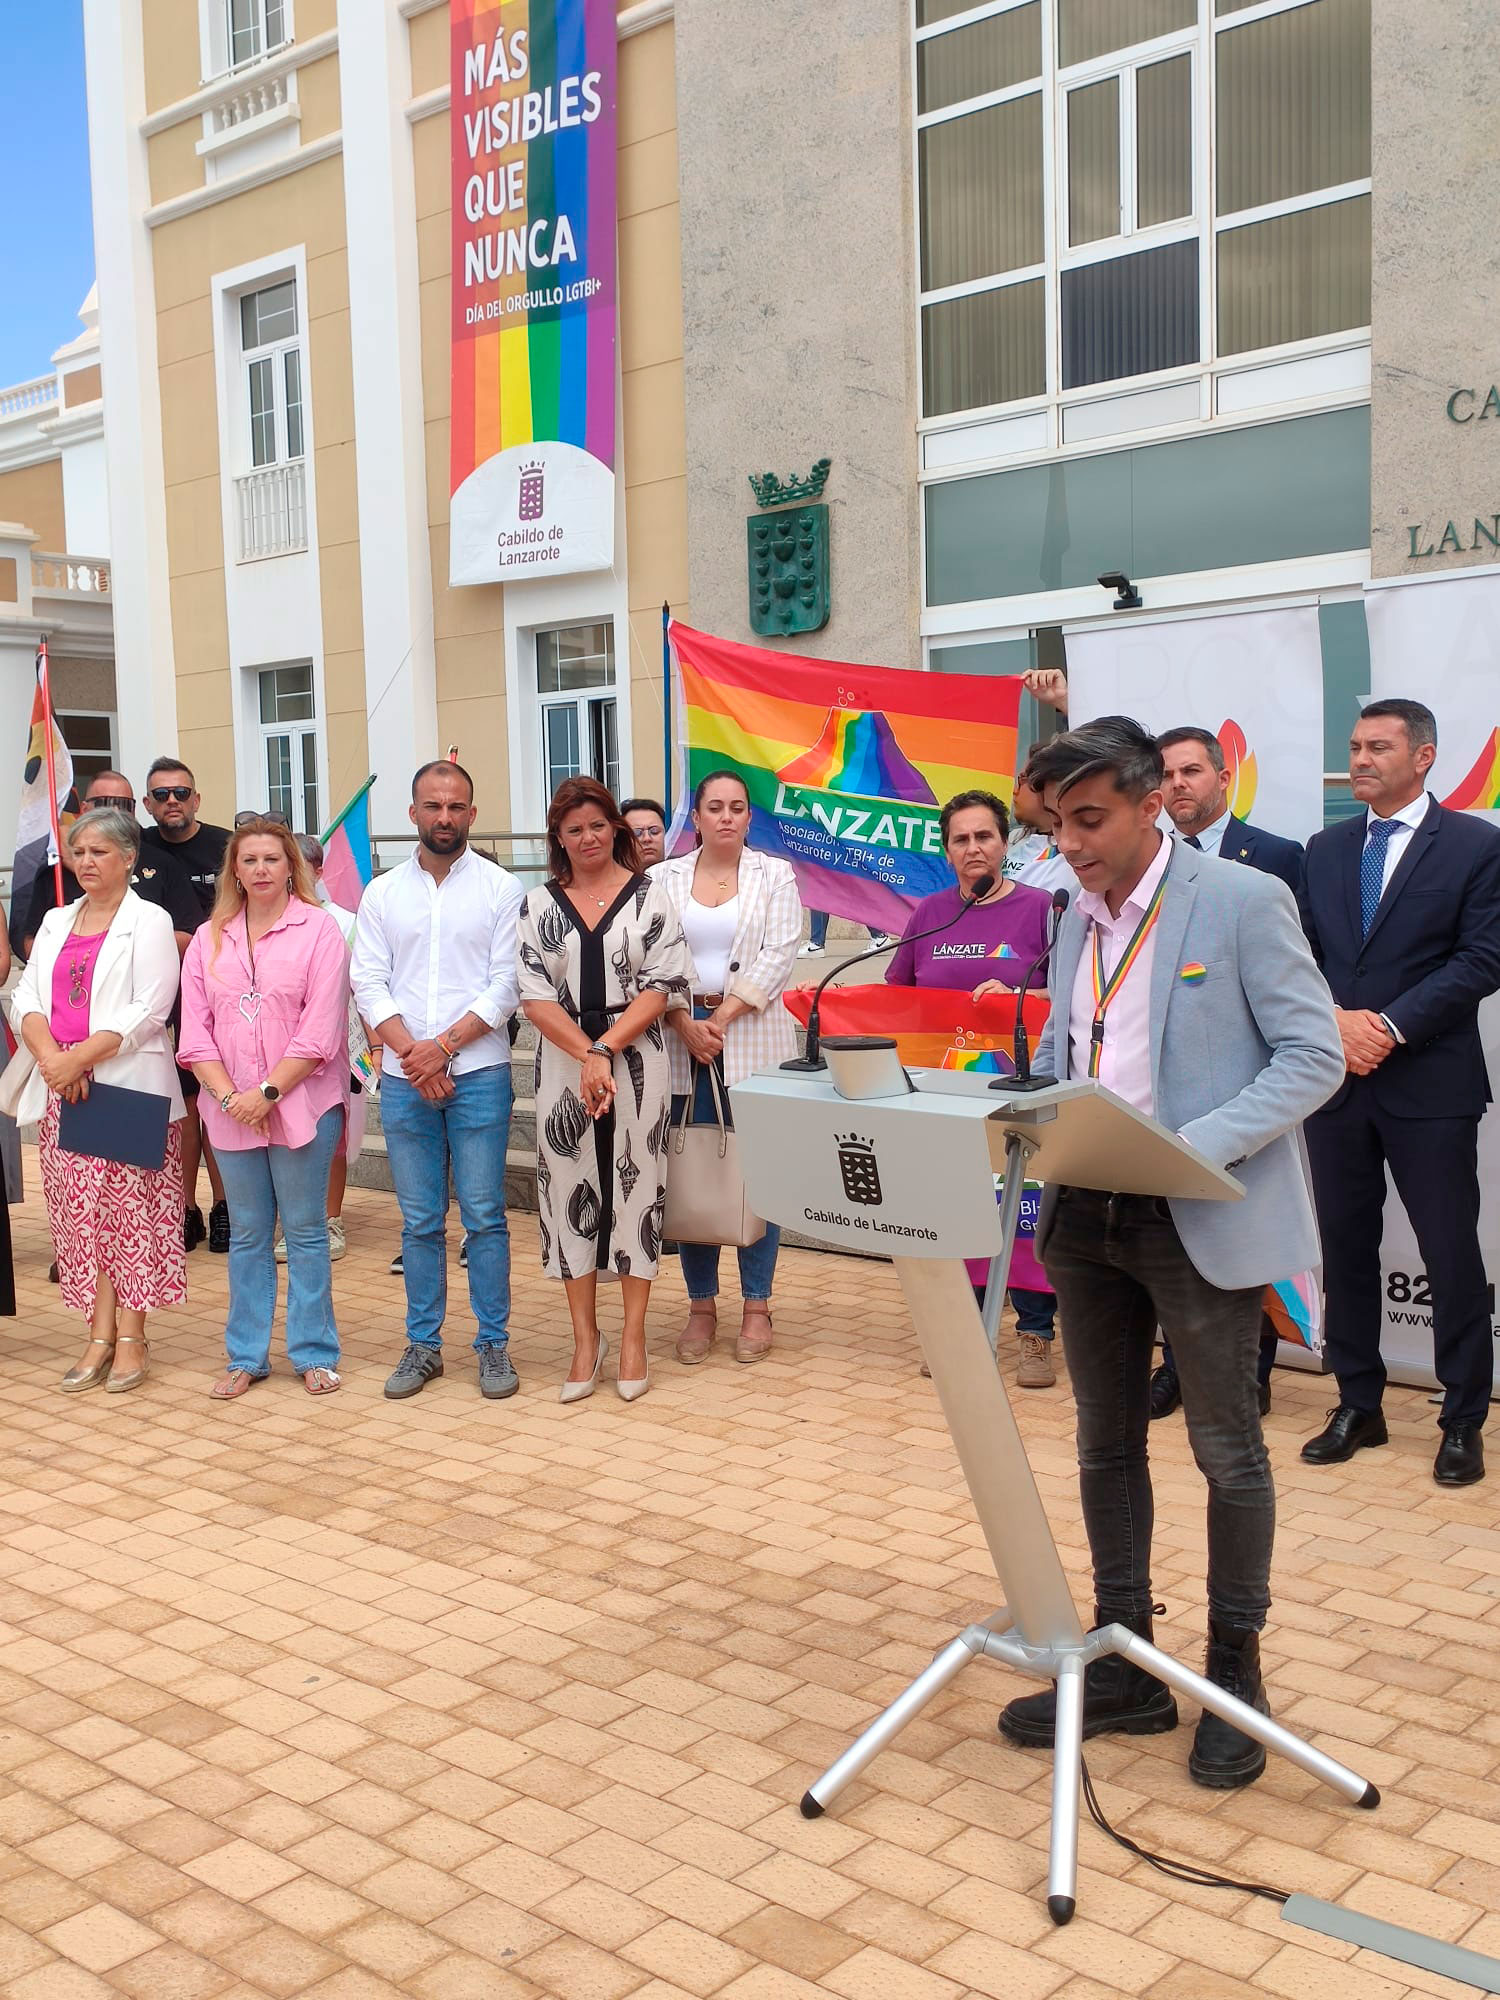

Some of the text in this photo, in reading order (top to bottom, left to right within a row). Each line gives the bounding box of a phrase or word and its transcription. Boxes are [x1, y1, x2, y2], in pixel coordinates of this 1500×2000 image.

[464, 26, 528, 96] MÁS
[463, 71, 602, 159] VISIBLES
[464, 160, 524, 223] QUE
[464, 214, 577, 287] NUNCA
[465, 277, 602, 325] DÍA DEL ORGULLO LGTBI+
[497, 524, 564, 547] Cabildo de
[498, 545, 561, 566] Lanzarote
[834, 852, 843, 866] y
[878, 853, 895, 868] de
[933, 942, 987, 955] LÁNZATE
[804, 1207, 938, 1240] Cabildo de Lanzarote
